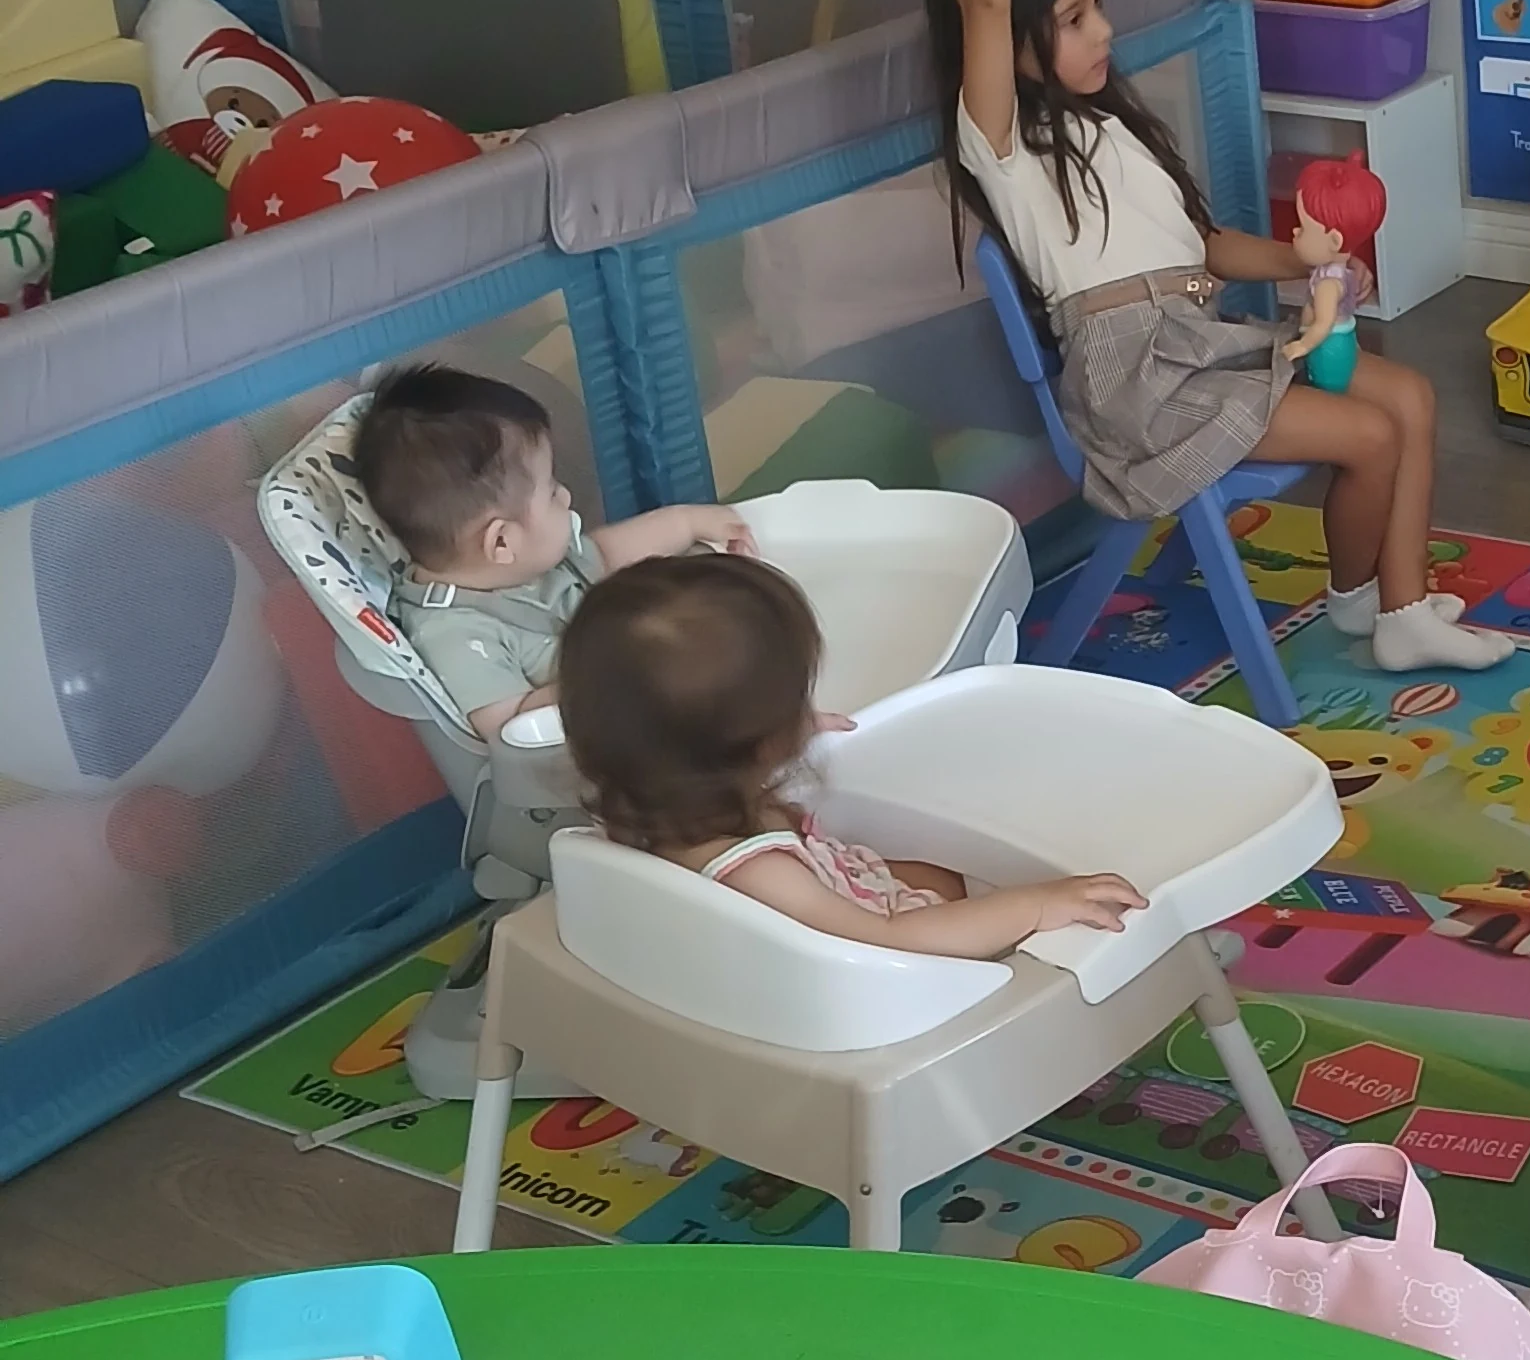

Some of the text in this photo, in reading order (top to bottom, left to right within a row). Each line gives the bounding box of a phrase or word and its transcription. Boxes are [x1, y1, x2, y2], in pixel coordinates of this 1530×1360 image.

[1472, 747, 1509, 766] 8
[1323, 878, 1359, 908] BLUE
[288, 1072, 420, 1130] Vampe
[1310, 1061, 1406, 1106] HEXAGON
[1403, 1130, 1524, 1160] RECTANGLE
[500, 1162, 612, 1218] nicorn
